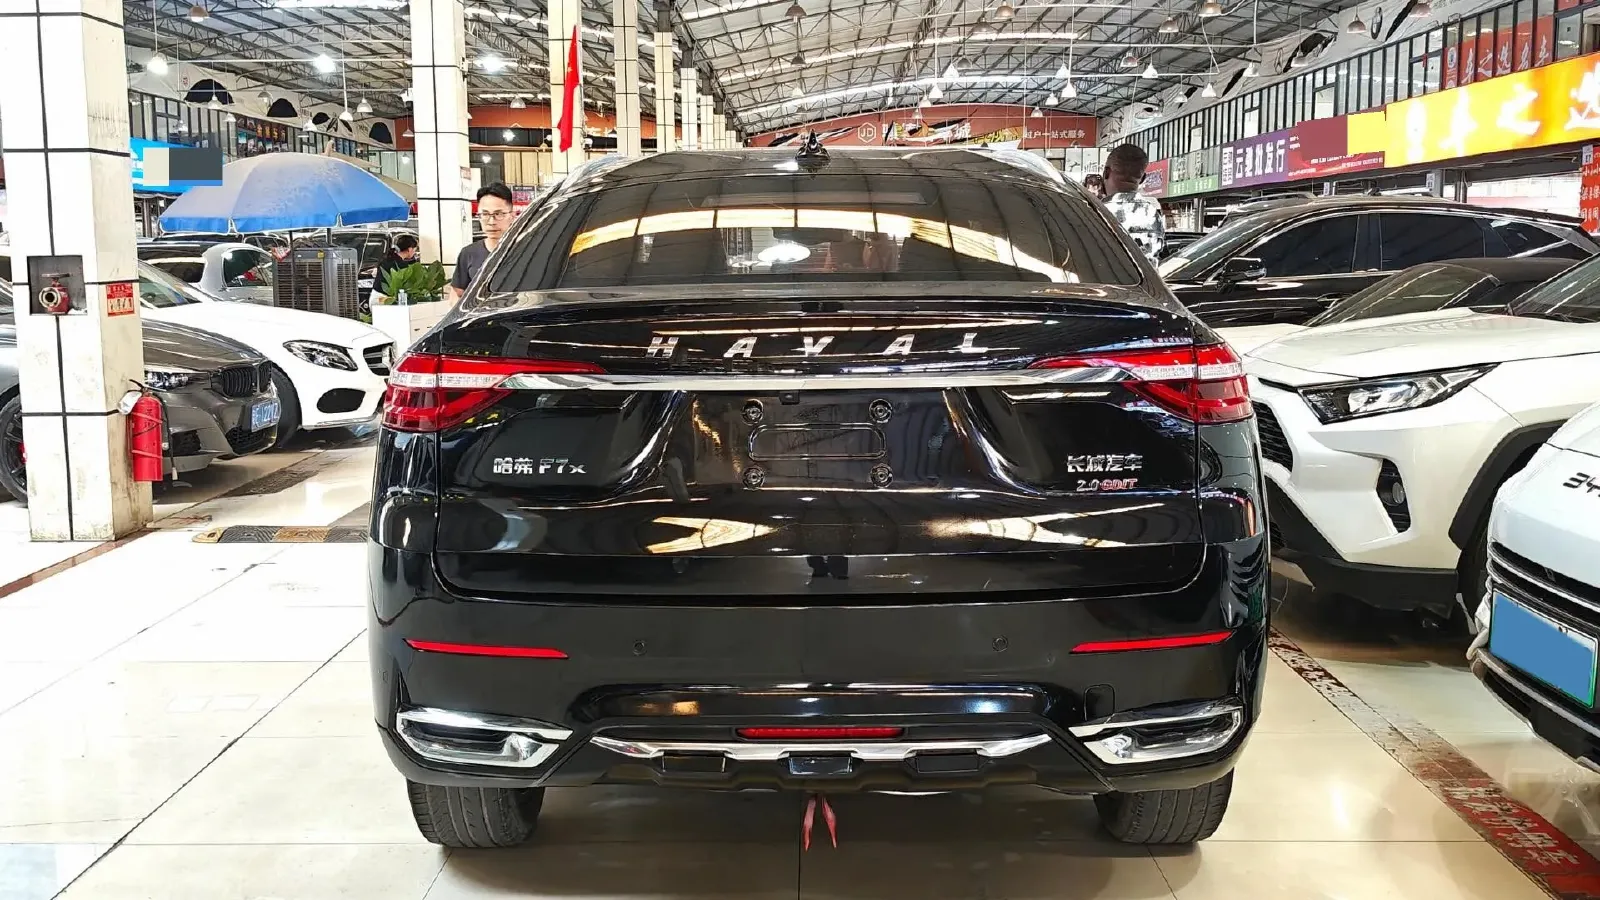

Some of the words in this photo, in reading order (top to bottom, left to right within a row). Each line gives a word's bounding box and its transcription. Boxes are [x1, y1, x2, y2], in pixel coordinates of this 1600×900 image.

[645, 332, 989, 359] HAVAL
[493, 457, 533, 475] 哈弗
[538, 458, 587, 474] F7x
[1066, 453, 1143, 473] 长城汽车
